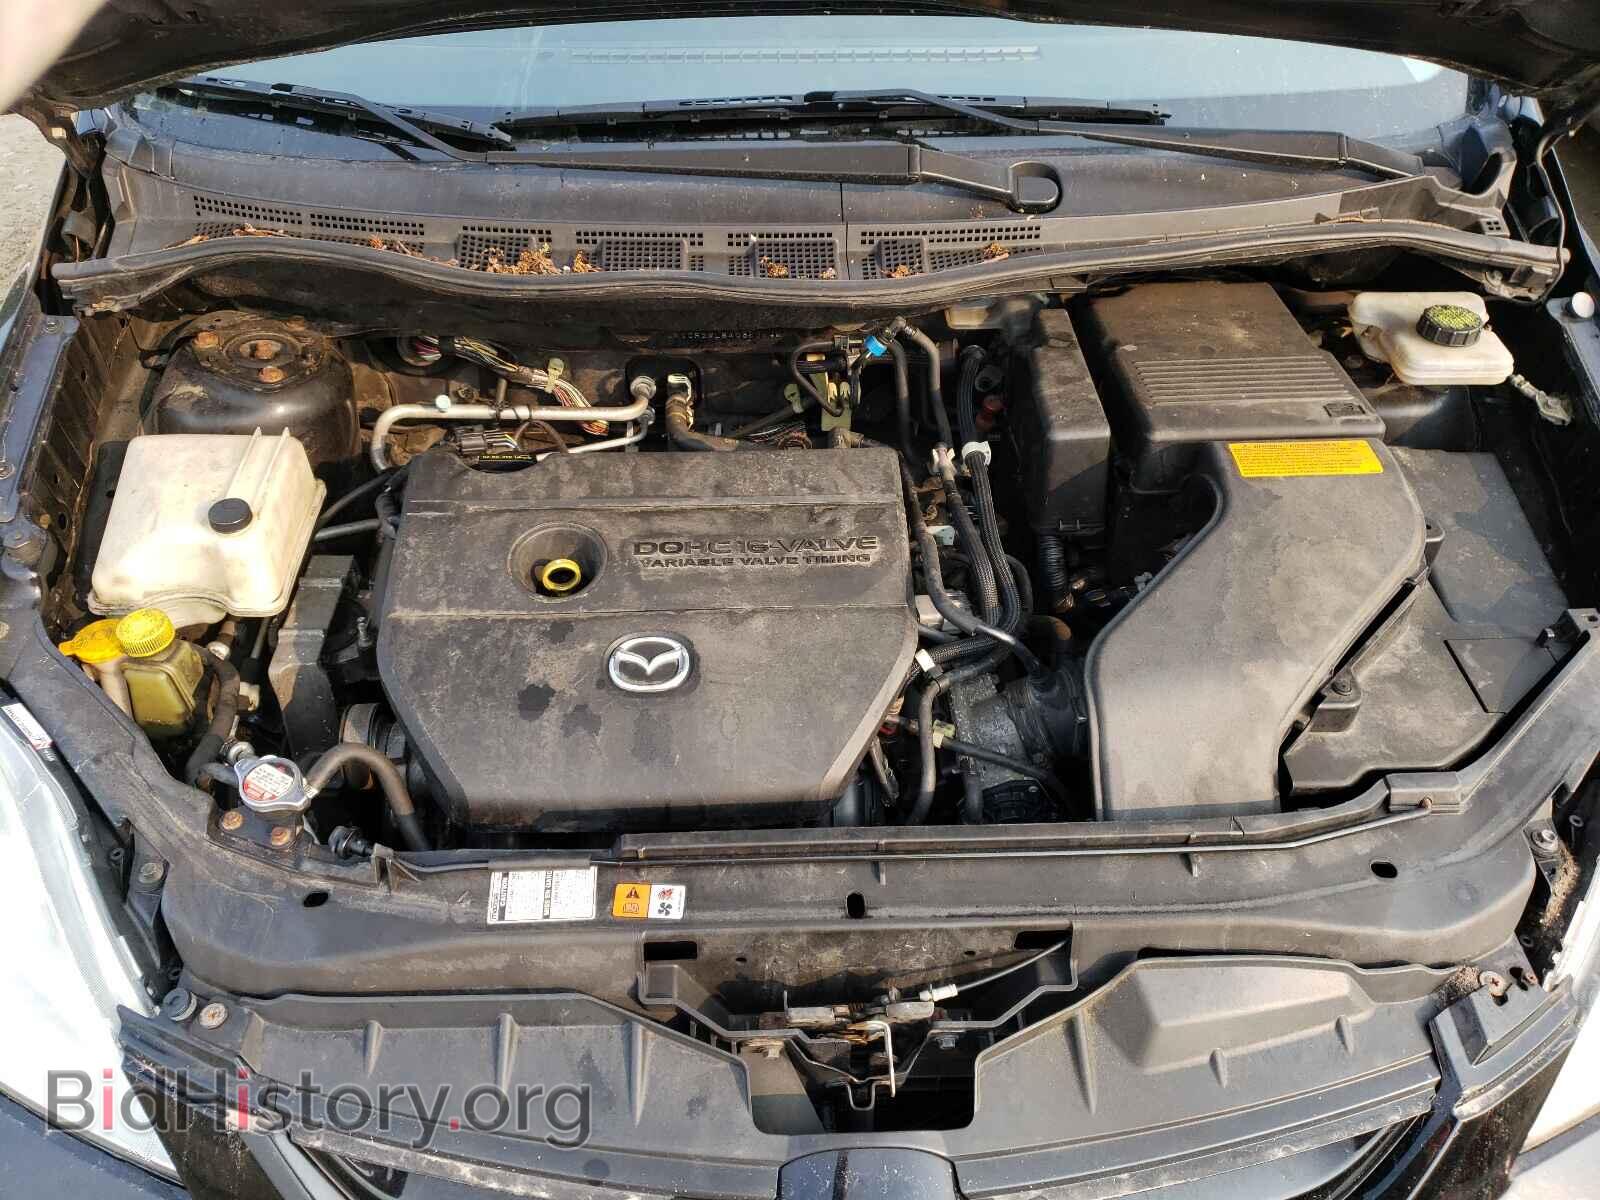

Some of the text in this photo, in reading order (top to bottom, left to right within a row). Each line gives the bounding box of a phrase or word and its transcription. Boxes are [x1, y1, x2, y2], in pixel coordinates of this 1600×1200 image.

[632, 541, 732, 556] DOHC
[640, 553, 871, 568] VARIABLE VALVE TIMING
[499, 876, 508, 907] CAUTION
